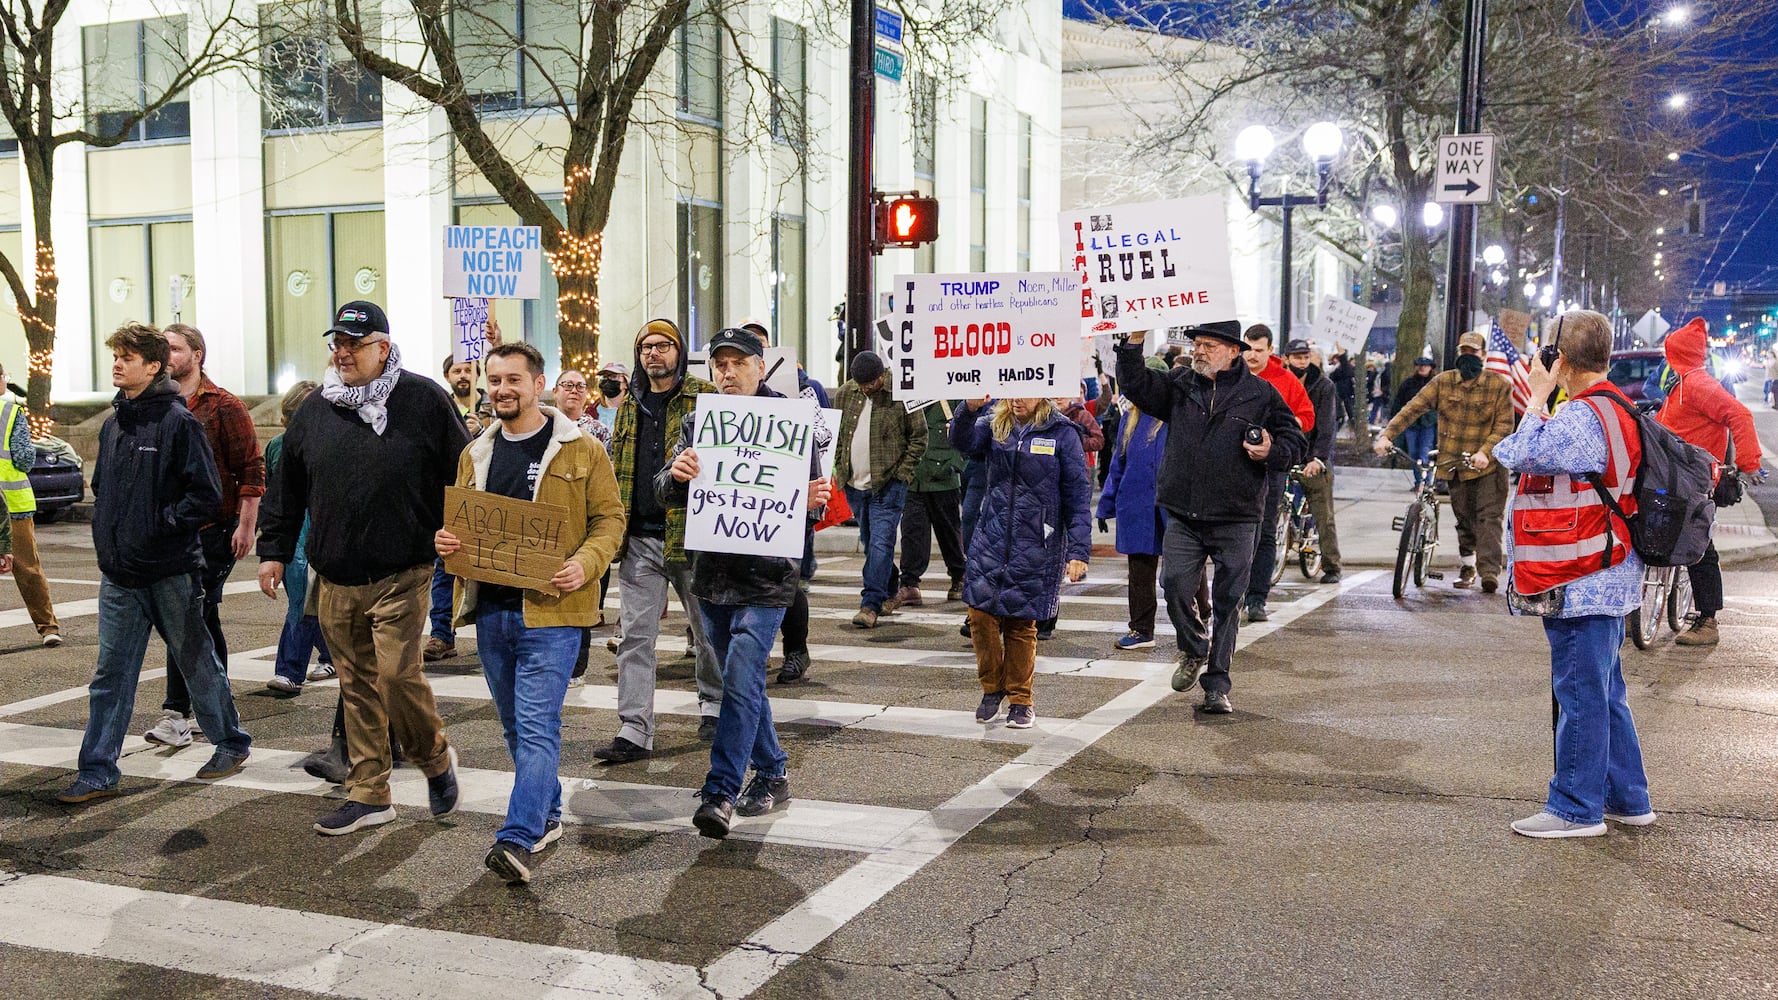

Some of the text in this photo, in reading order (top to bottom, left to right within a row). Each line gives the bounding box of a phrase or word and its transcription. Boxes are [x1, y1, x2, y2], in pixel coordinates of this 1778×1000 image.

[1447, 141, 1484, 156] ONE
[1446, 159, 1485, 174] WAY
[447, 227, 539, 249] IMPEACH
[462, 251, 522, 272] NOEM
[1098, 249, 1176, 283] RUEL
[468, 274, 517, 296] NOW
[941, 278, 1078, 296] TRUMP Noem, Miller
[928, 297, 943, 312] and
[950, 298, 972, 311] other
[1009, 296, 1059, 314] Republicans
[1126, 291, 1209, 313] XTREME
[454, 306, 488, 325] TERRORIS
[460, 320, 487, 344] ICE
[934, 322, 1011, 358] BLOOD
[1030, 333, 1056, 347] ON
[465, 341, 485, 361] IS!
[697, 409, 810, 457] ABOLISH
[734, 446, 761, 460] the
[715, 461, 779, 489] ICE
[693, 488, 800, 525] gestapo!
[452, 500, 562, 550] ABOLISH
[713, 513, 780, 543] NOW
[472, 537, 530, 577] ICE
